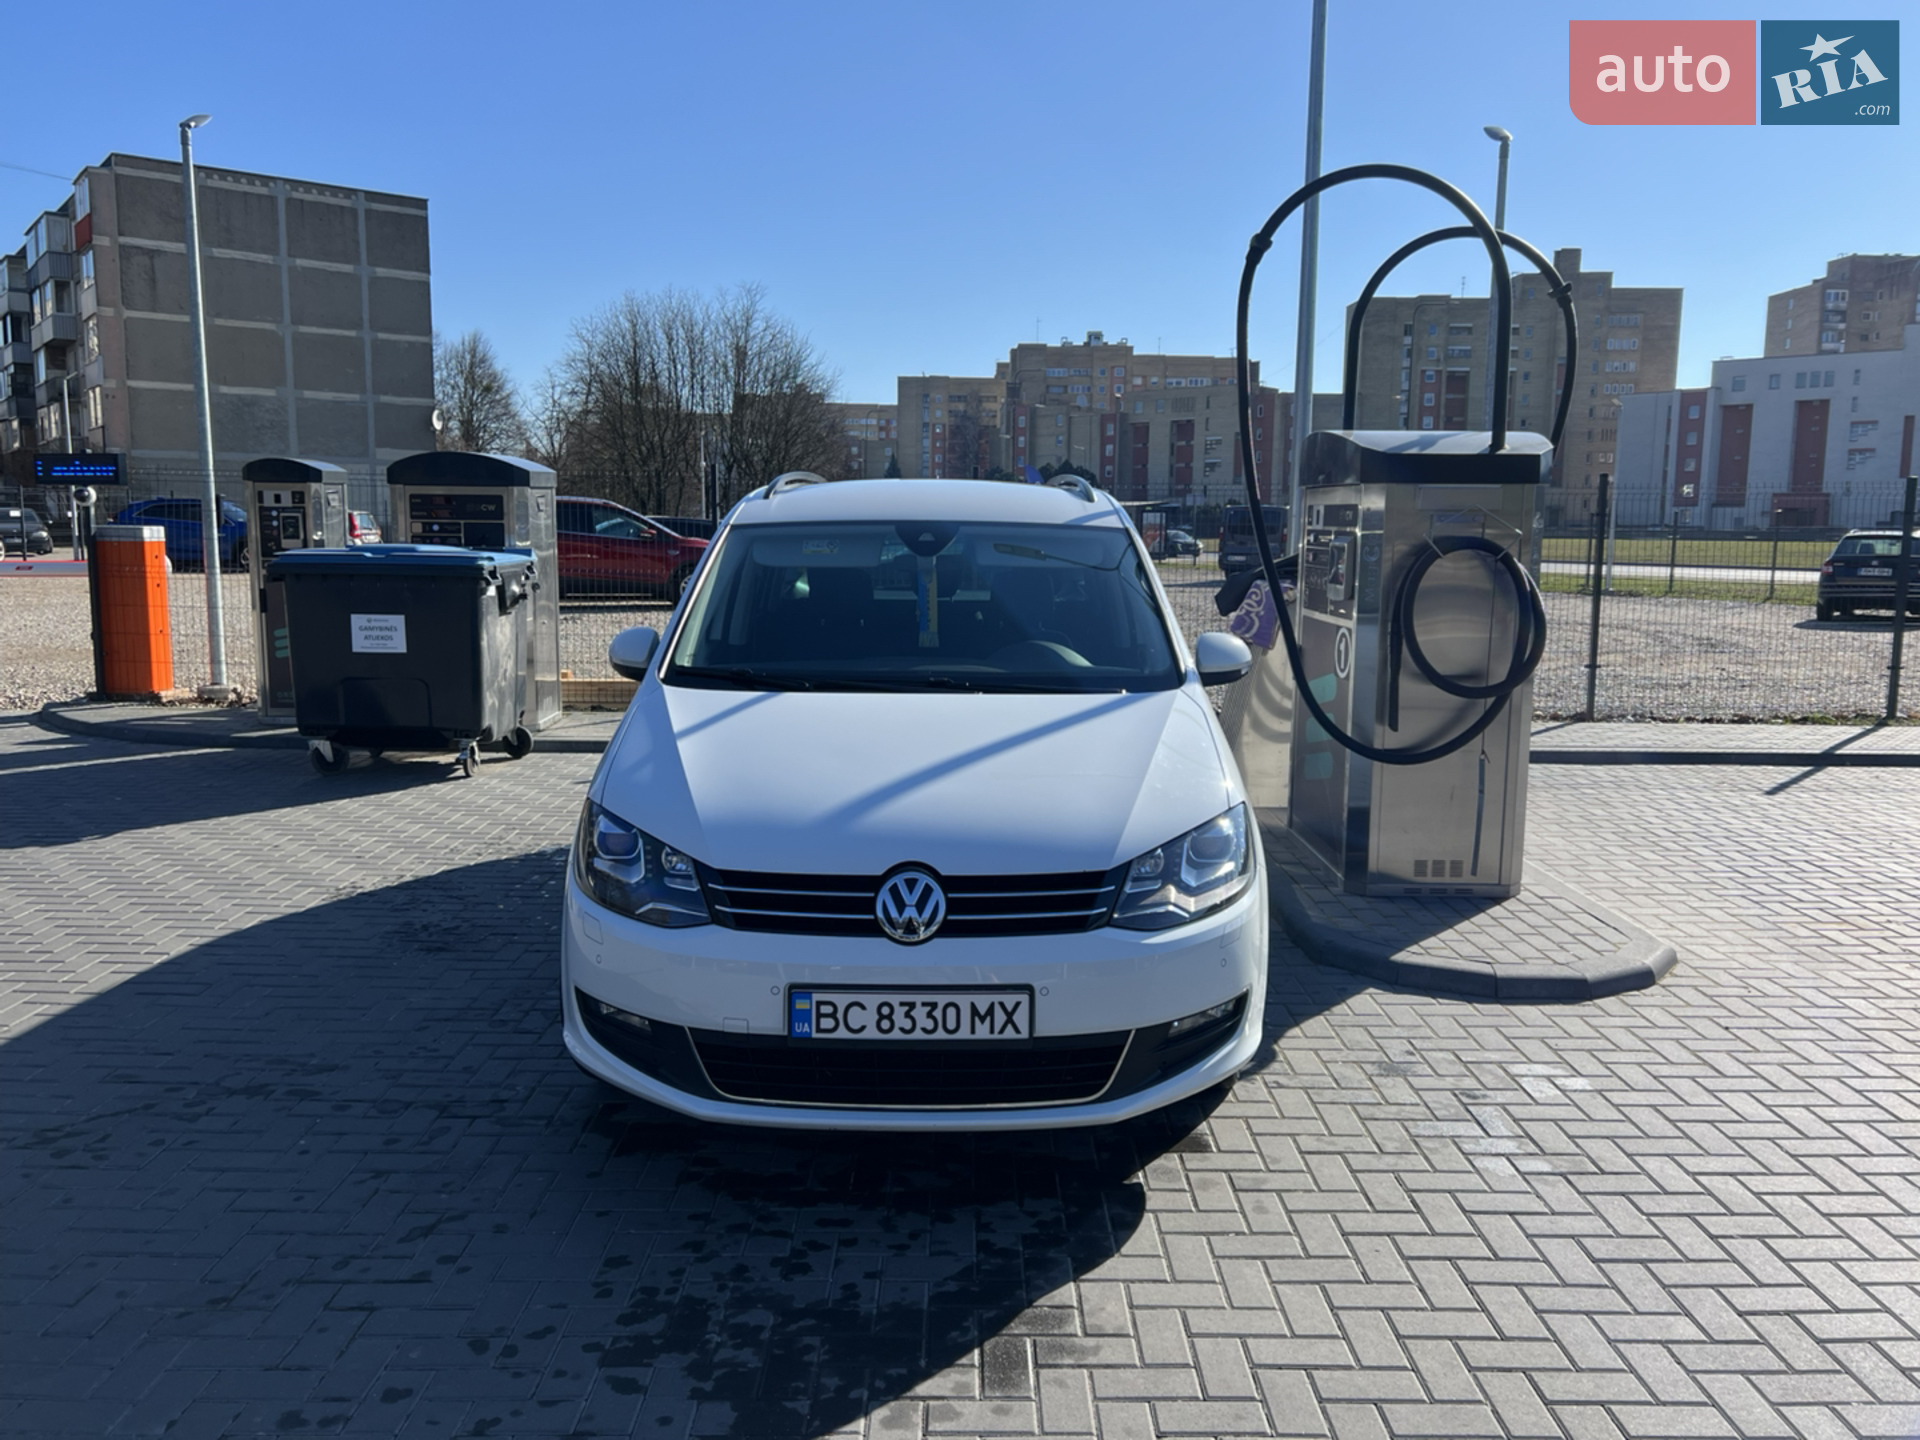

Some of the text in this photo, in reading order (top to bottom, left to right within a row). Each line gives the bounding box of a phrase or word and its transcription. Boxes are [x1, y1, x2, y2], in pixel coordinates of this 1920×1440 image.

[1339, 636, 1346, 669] 1
[795, 1022, 810, 1033] UA
[815, 1000, 1022, 1035] BC 8330 MX
